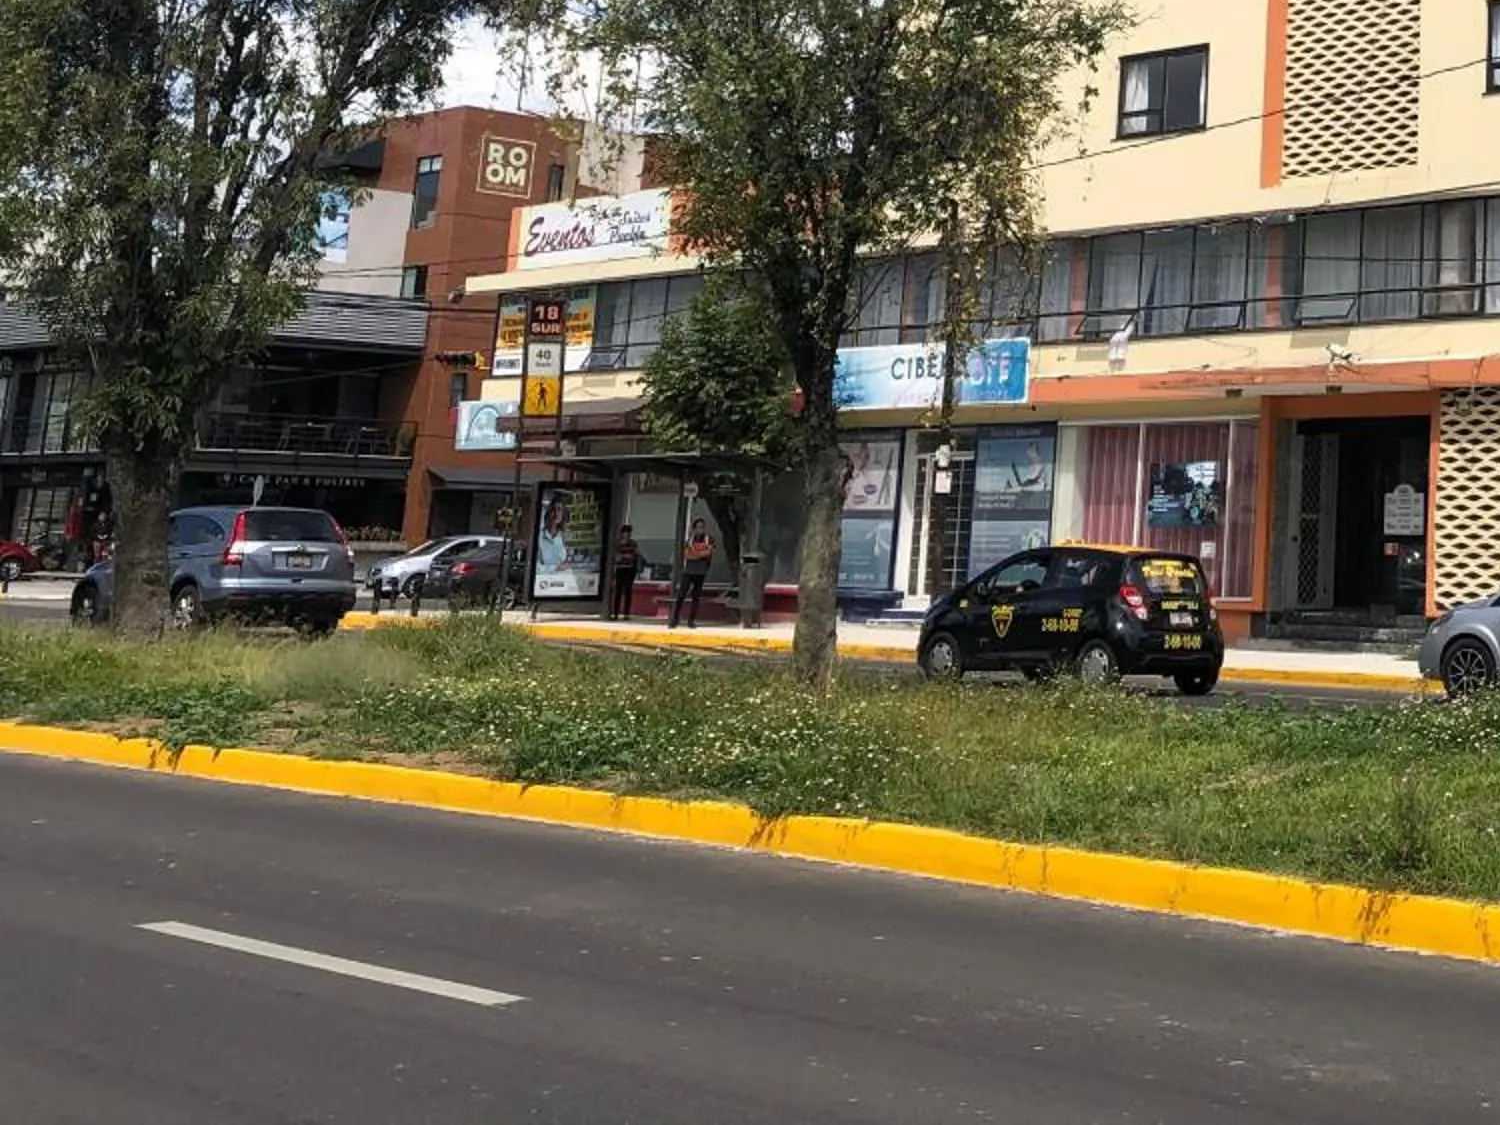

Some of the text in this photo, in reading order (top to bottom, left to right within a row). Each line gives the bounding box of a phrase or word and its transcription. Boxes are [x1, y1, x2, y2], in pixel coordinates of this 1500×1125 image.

[524, 215, 598, 258] Eventos
[534, 304, 560, 321] 18
[531, 321, 561, 335] SUR
[535, 349, 552, 361] 40
